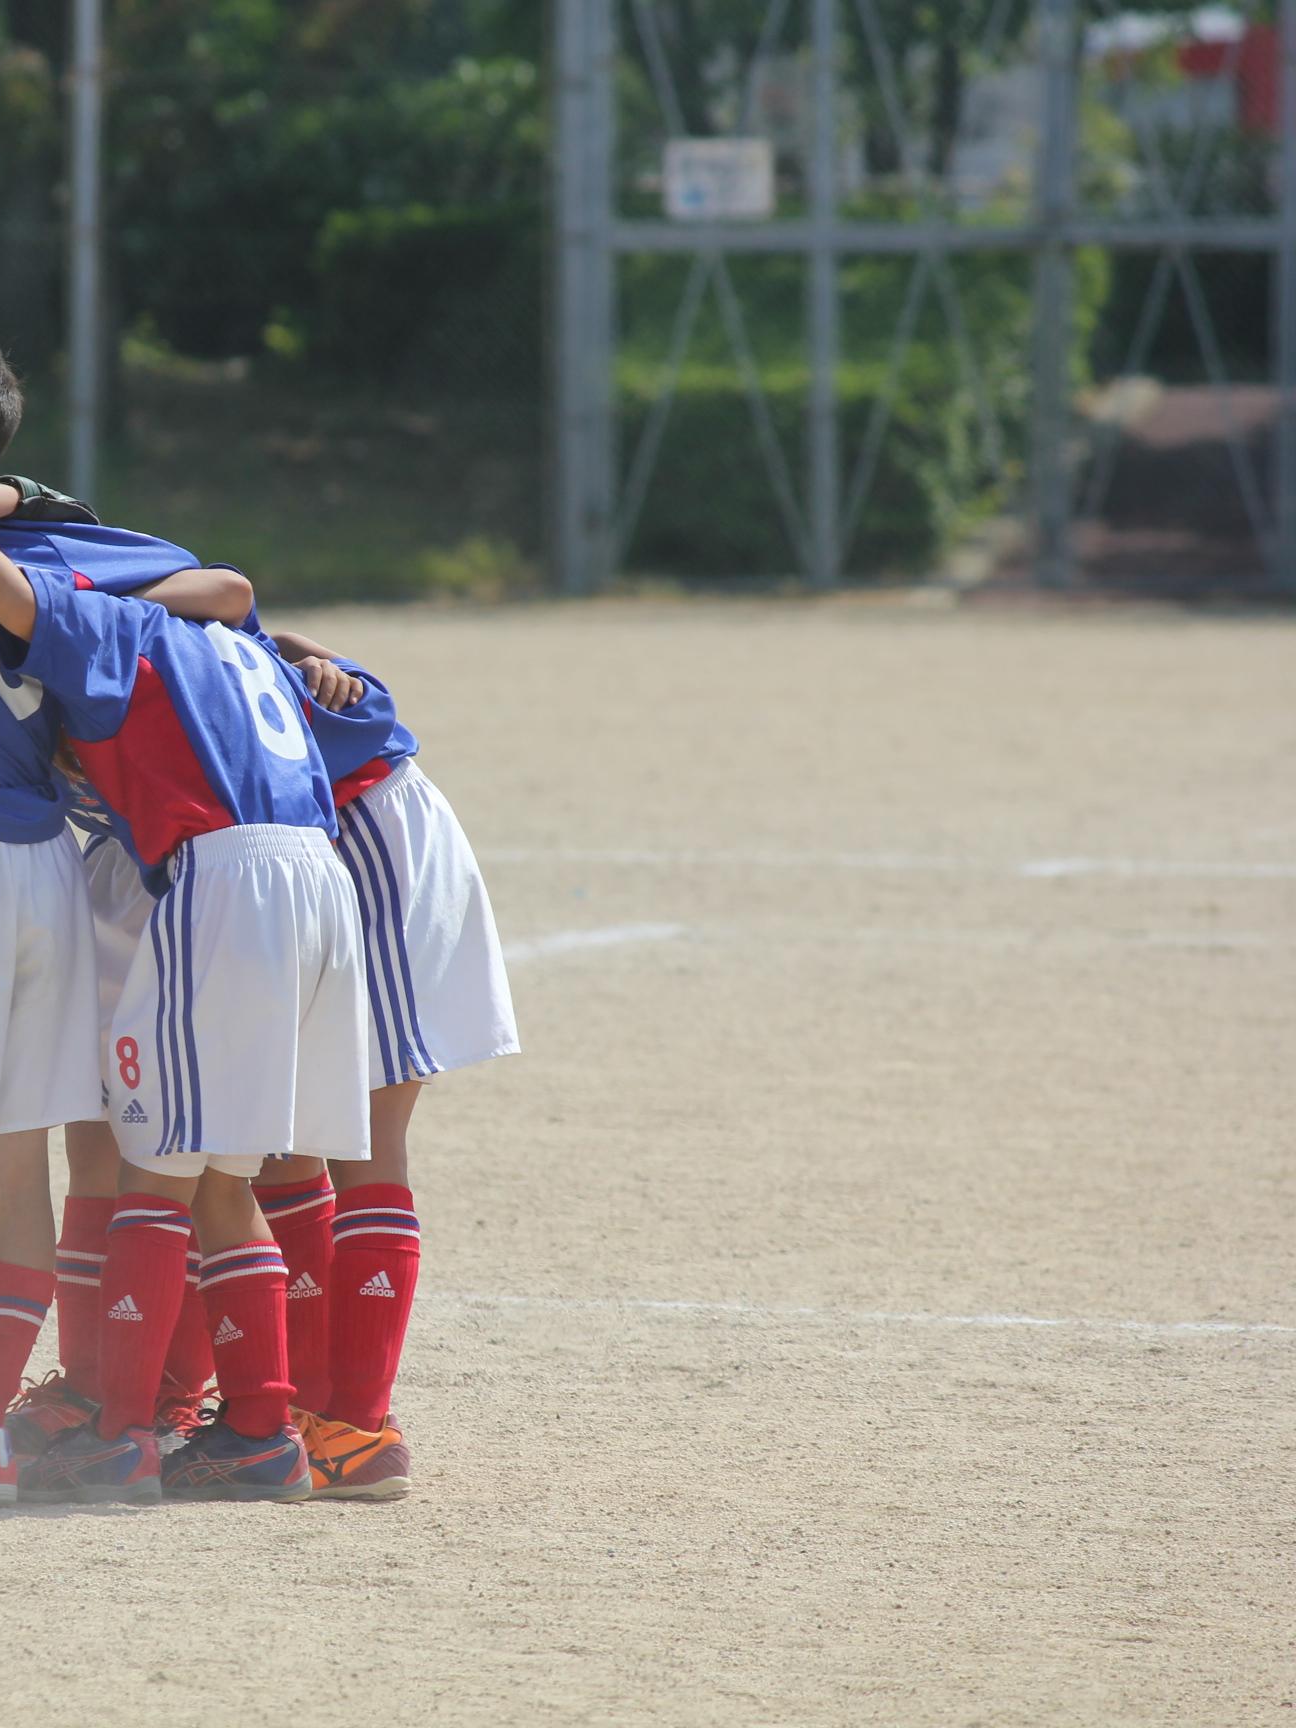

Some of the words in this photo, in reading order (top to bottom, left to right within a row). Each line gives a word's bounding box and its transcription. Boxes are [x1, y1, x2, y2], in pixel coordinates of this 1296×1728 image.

[204, 621, 308, 760] 8
[115, 1036, 141, 1090] 8
[121, 1113, 148, 1123] adidas
[286, 1286, 323, 1299] adidas
[359, 1286, 395, 1298] adidas
[108, 1310, 143, 1321] adidas
[214, 1330, 244, 1345] adidas
